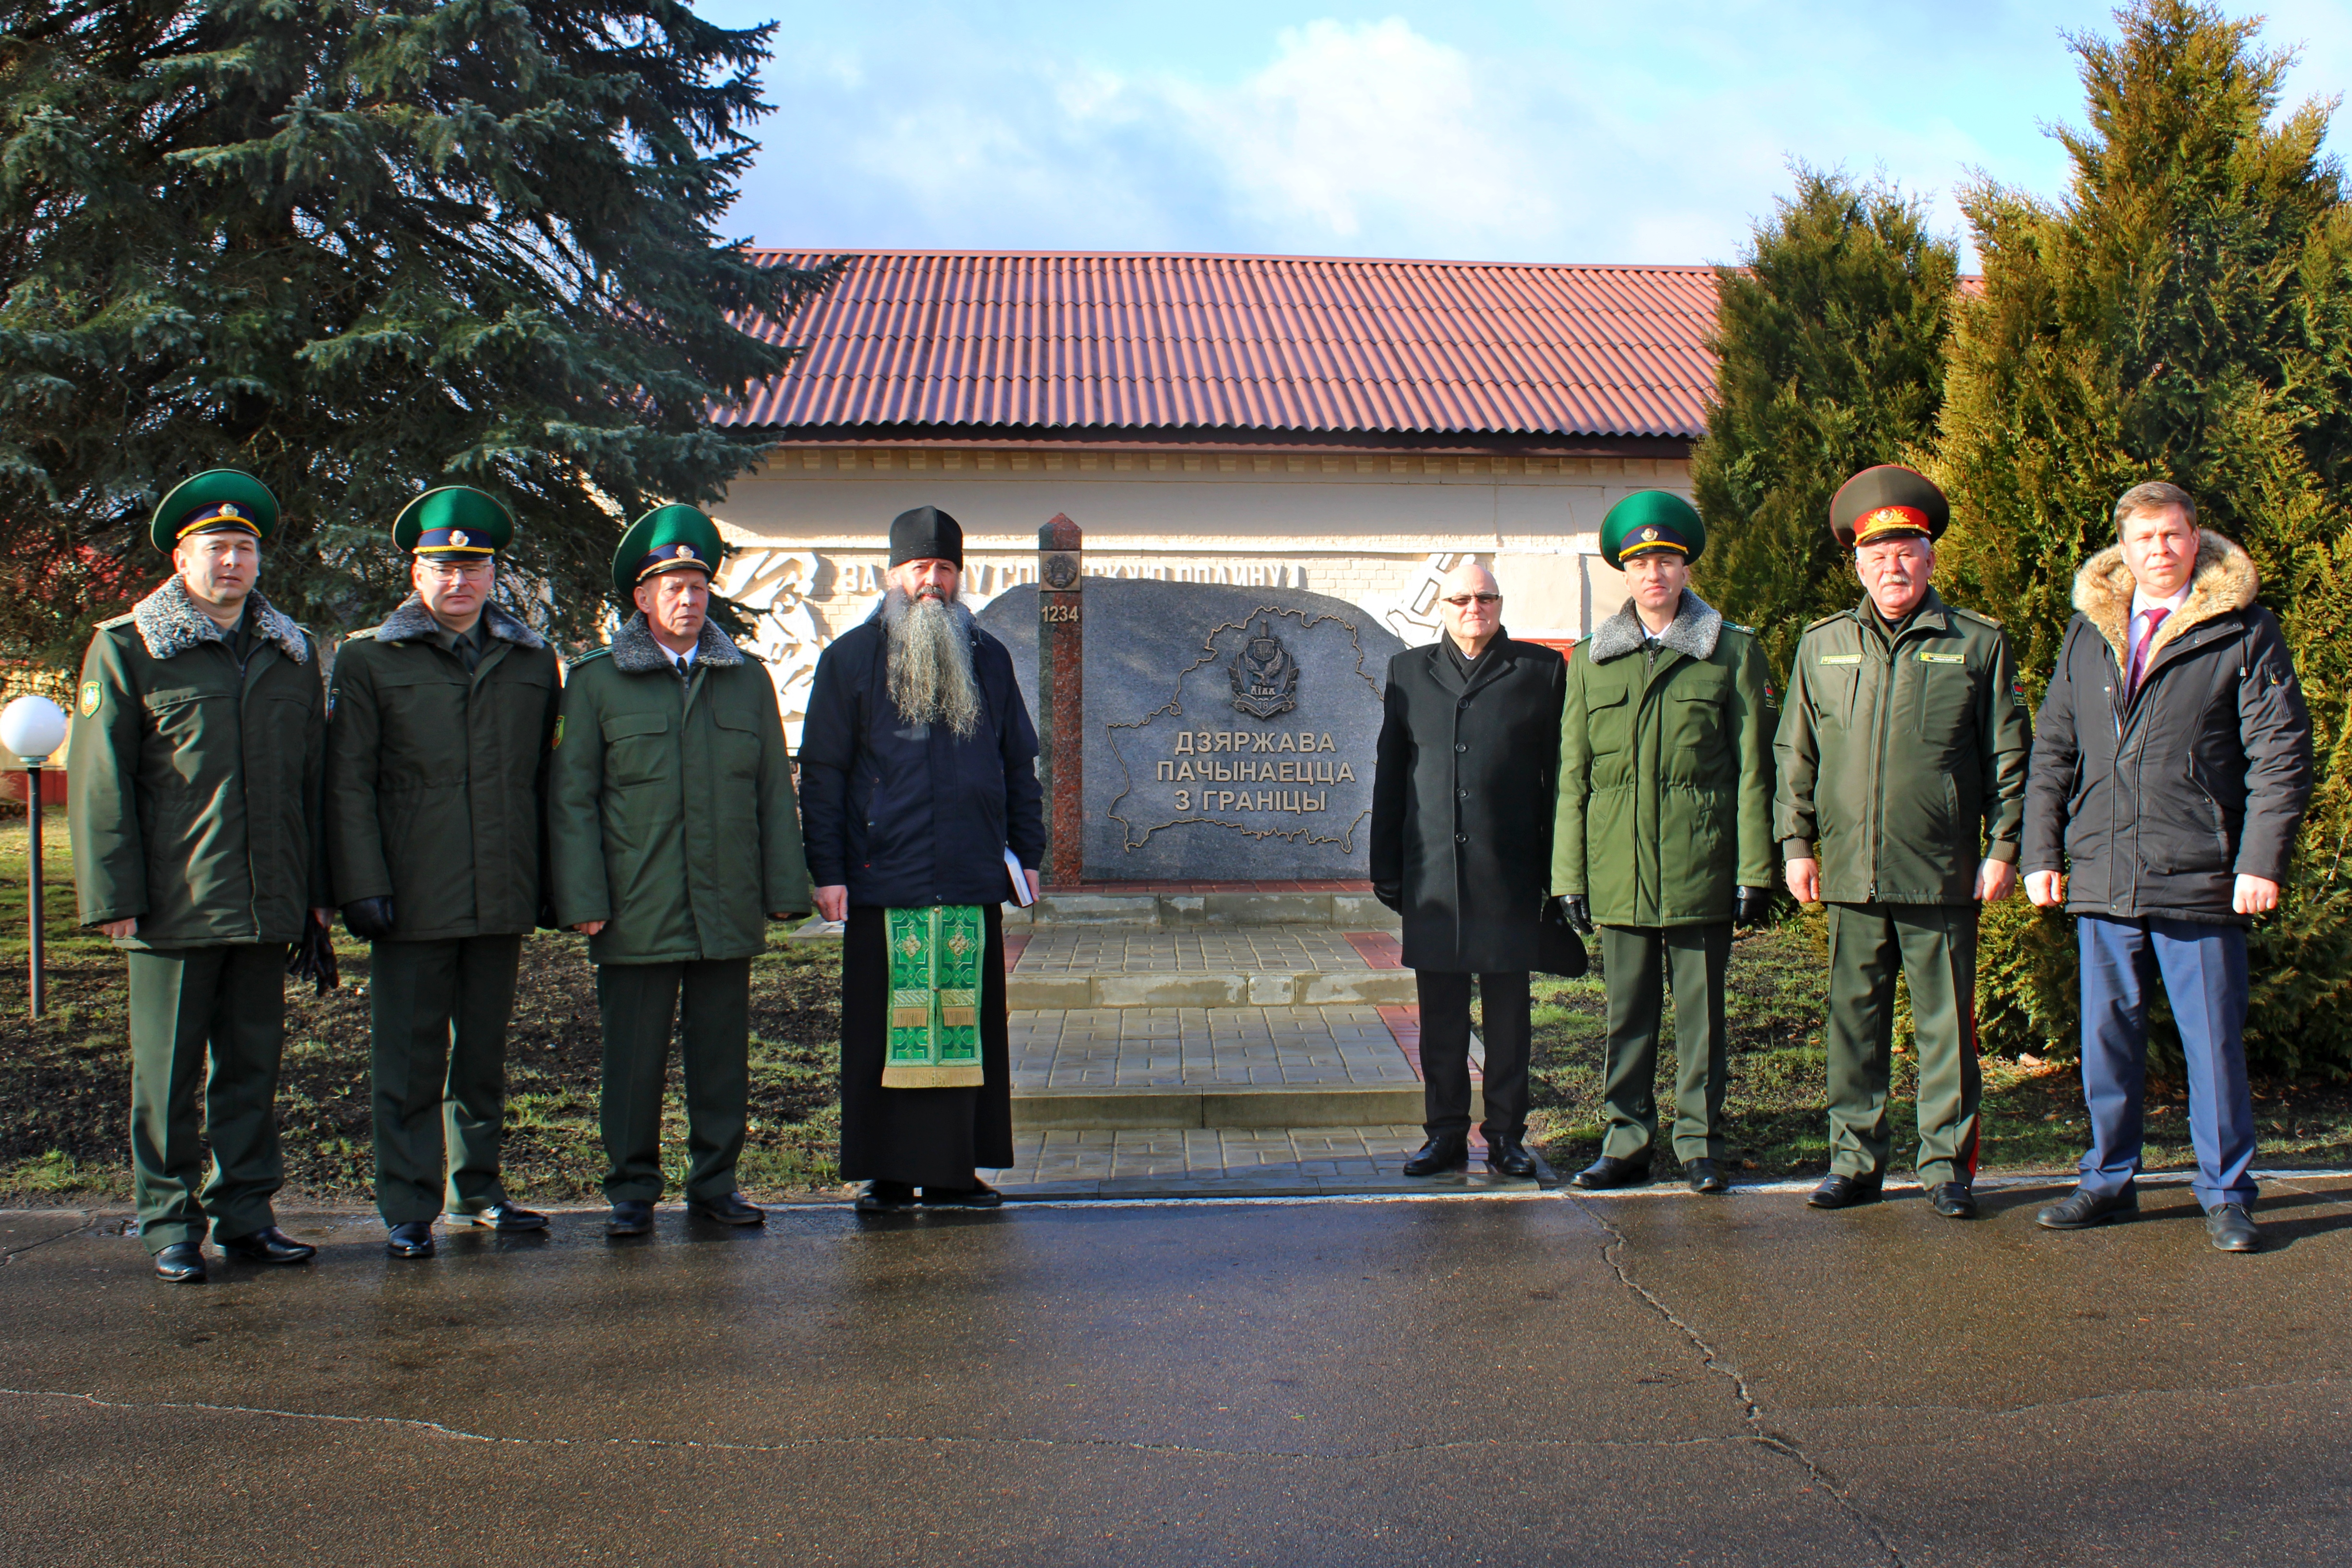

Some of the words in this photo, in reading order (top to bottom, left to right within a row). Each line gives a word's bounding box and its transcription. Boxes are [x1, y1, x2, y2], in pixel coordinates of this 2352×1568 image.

[1041, 606, 1079, 622] 1234
[1259, 701, 1269, 710] 18
[1175, 732, 1336, 756] ДЗЯРЖАВА
[1157, 761, 1356, 785] ПАЧЫНАЕЦЦА
[1175, 790, 1191, 811] З
[1203, 791, 1326, 815] ГРАНІЦЫ
